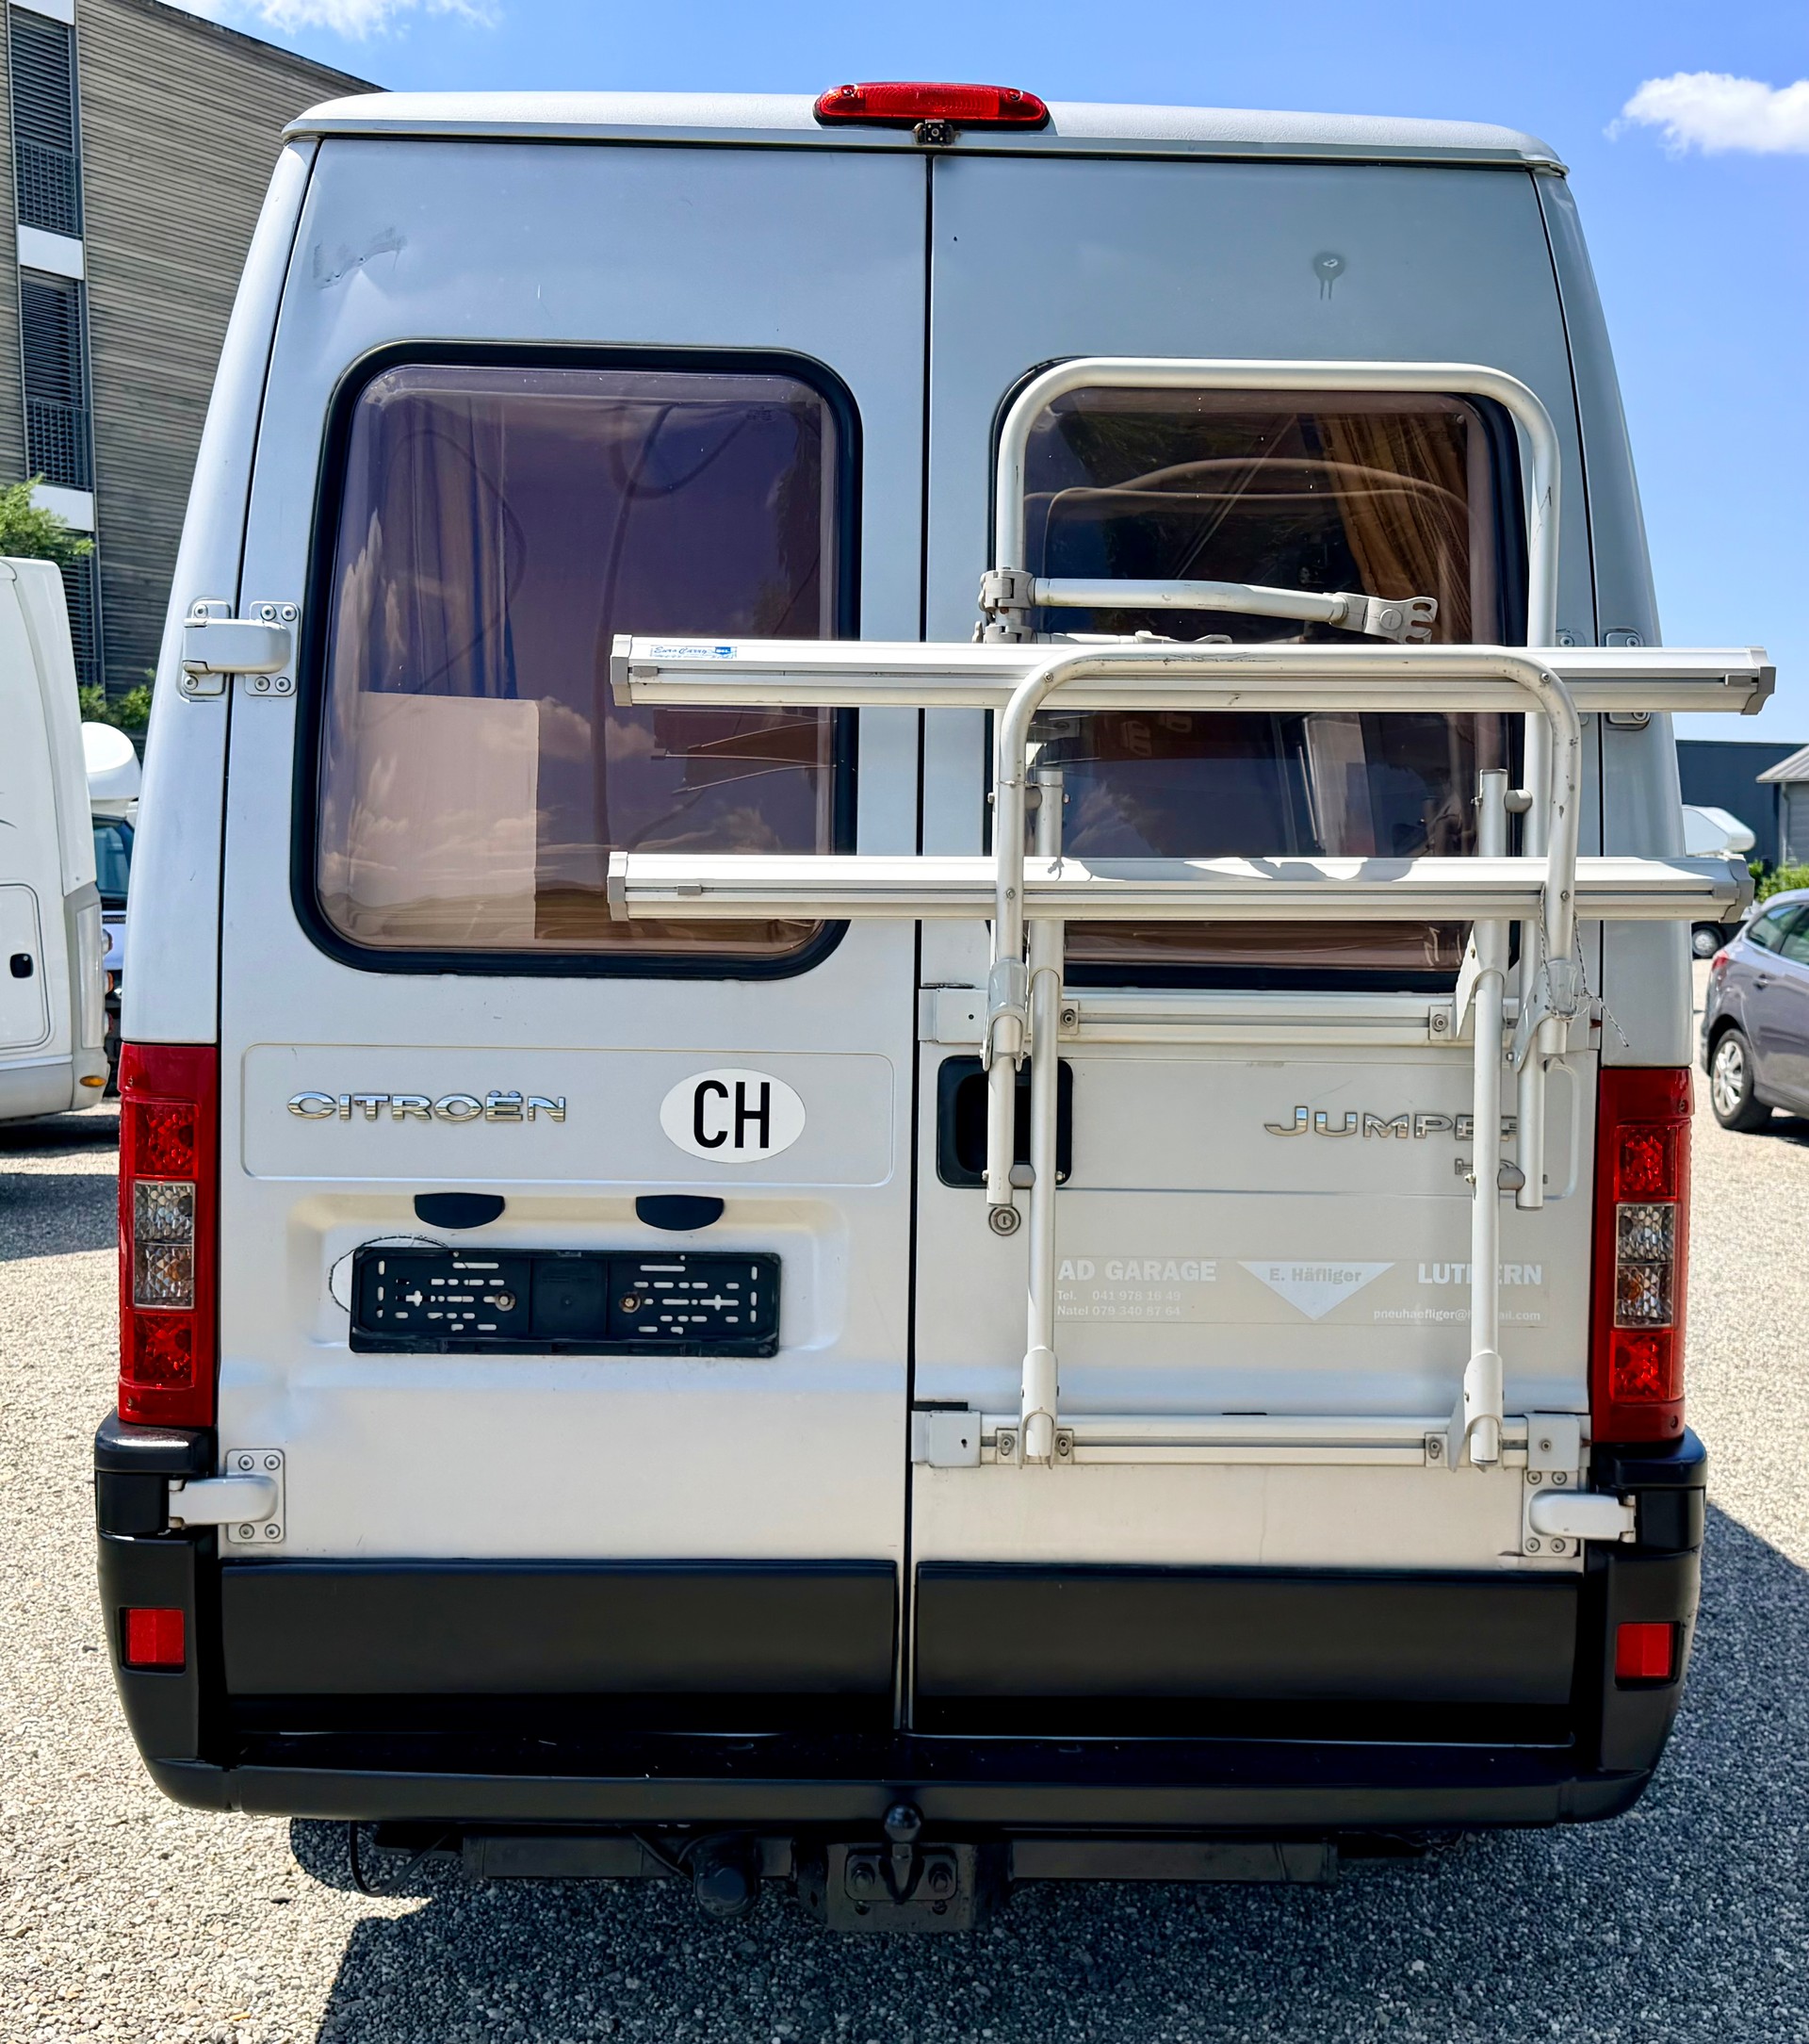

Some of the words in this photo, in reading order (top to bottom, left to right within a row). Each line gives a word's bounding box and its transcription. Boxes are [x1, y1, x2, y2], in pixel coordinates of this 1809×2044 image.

[286, 1090, 565, 1121] CITROËN
[693, 1080, 770, 1149] CH
[1057, 1260, 1095, 1281] AD
[1105, 1260, 1216, 1282] GARAGE
[1269, 1267, 1285, 1282] E.
[1291, 1267, 1362, 1284] Häfliger
[1418, 1263, 1542, 1285] LUTRN
[1056, 1289, 1077, 1301] Tel.
[1092, 1290, 1116, 1301] 041
[1056, 1305, 1088, 1316] Natel
[1092, 1305, 1116, 1316] 079
